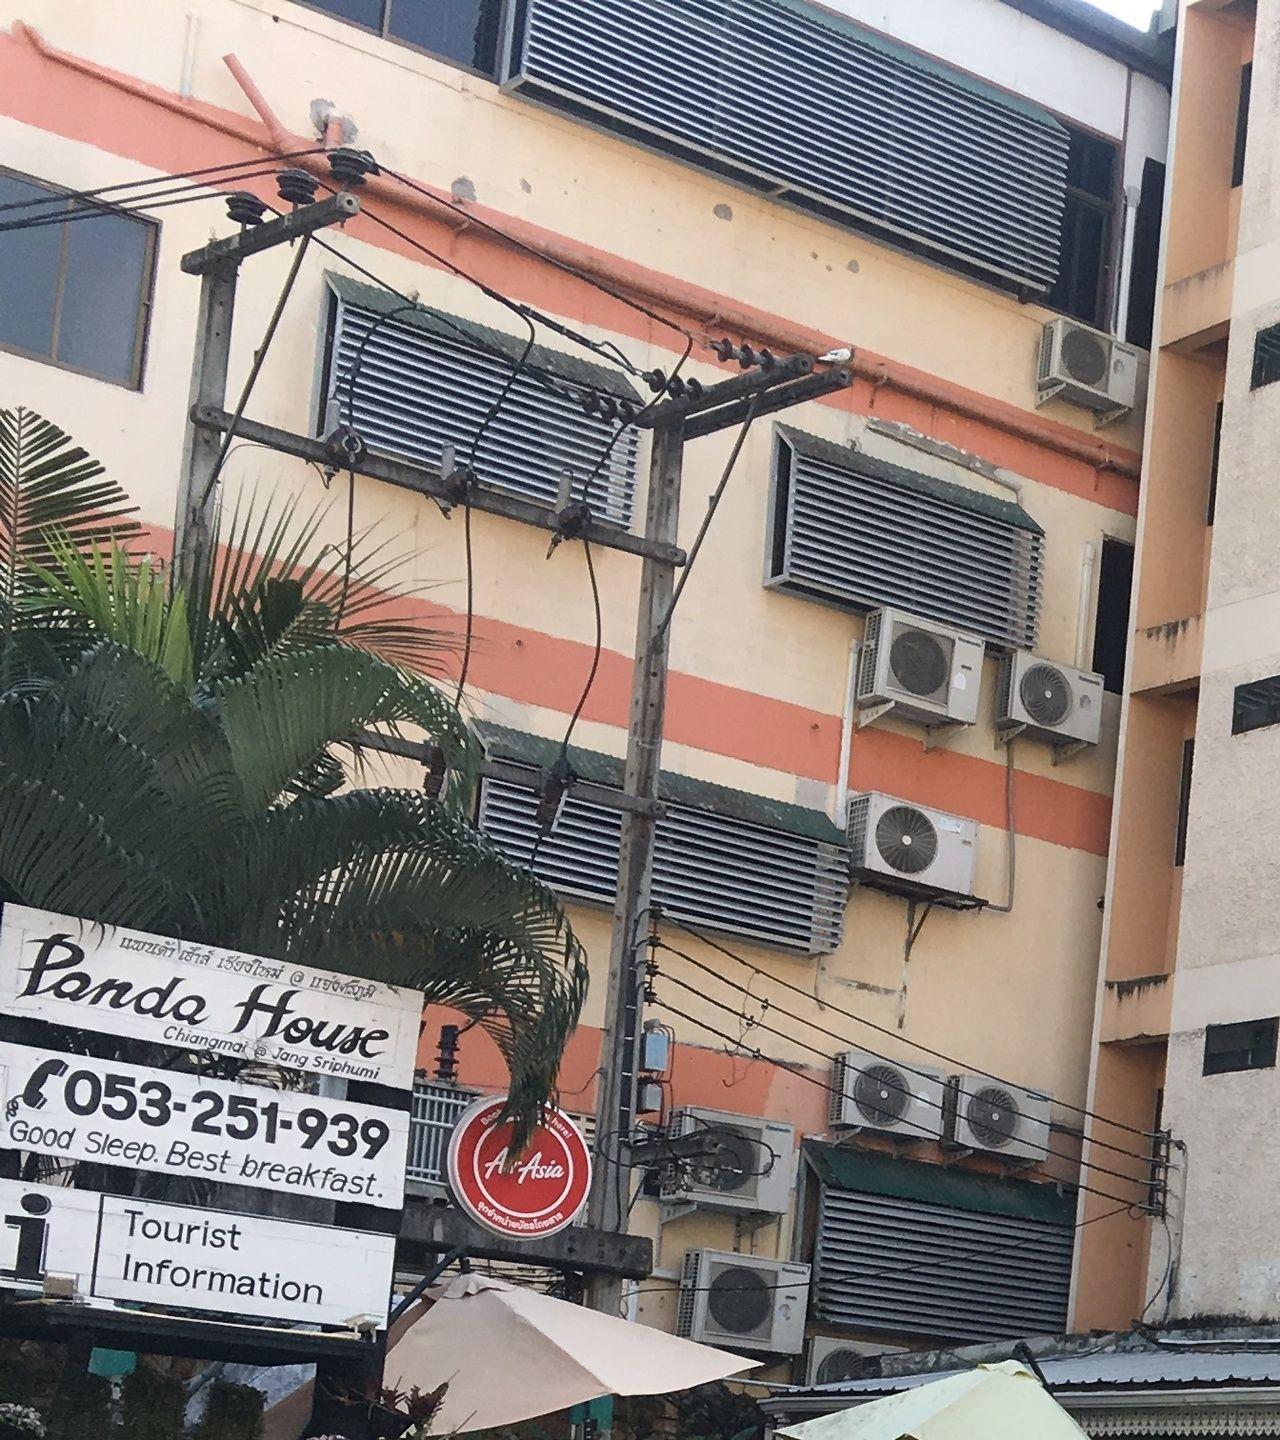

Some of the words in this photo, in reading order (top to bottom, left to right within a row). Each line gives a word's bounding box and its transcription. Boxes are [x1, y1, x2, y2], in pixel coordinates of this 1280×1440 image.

[15, 933, 209, 1026] Panda
[229, 983, 390, 1059] House
[163, 1025, 248, 1054] Chiangmai
[272, 1049, 309, 1068] Jang
[312, 1055, 381, 1080] Sriphumi
[64, 1069, 390, 1161] 053-251-939
[9, 1119, 77, 1150] Good
[84, 1131, 159, 1165] Sleep.
[165, 1140, 231, 1174] Best
[238, 1153, 384, 1199] breakfast.
[484, 1146, 565, 1185] ArAsia
[124, 1208, 242, 1251] Tourist
[122, 1253, 323, 1305] Information
